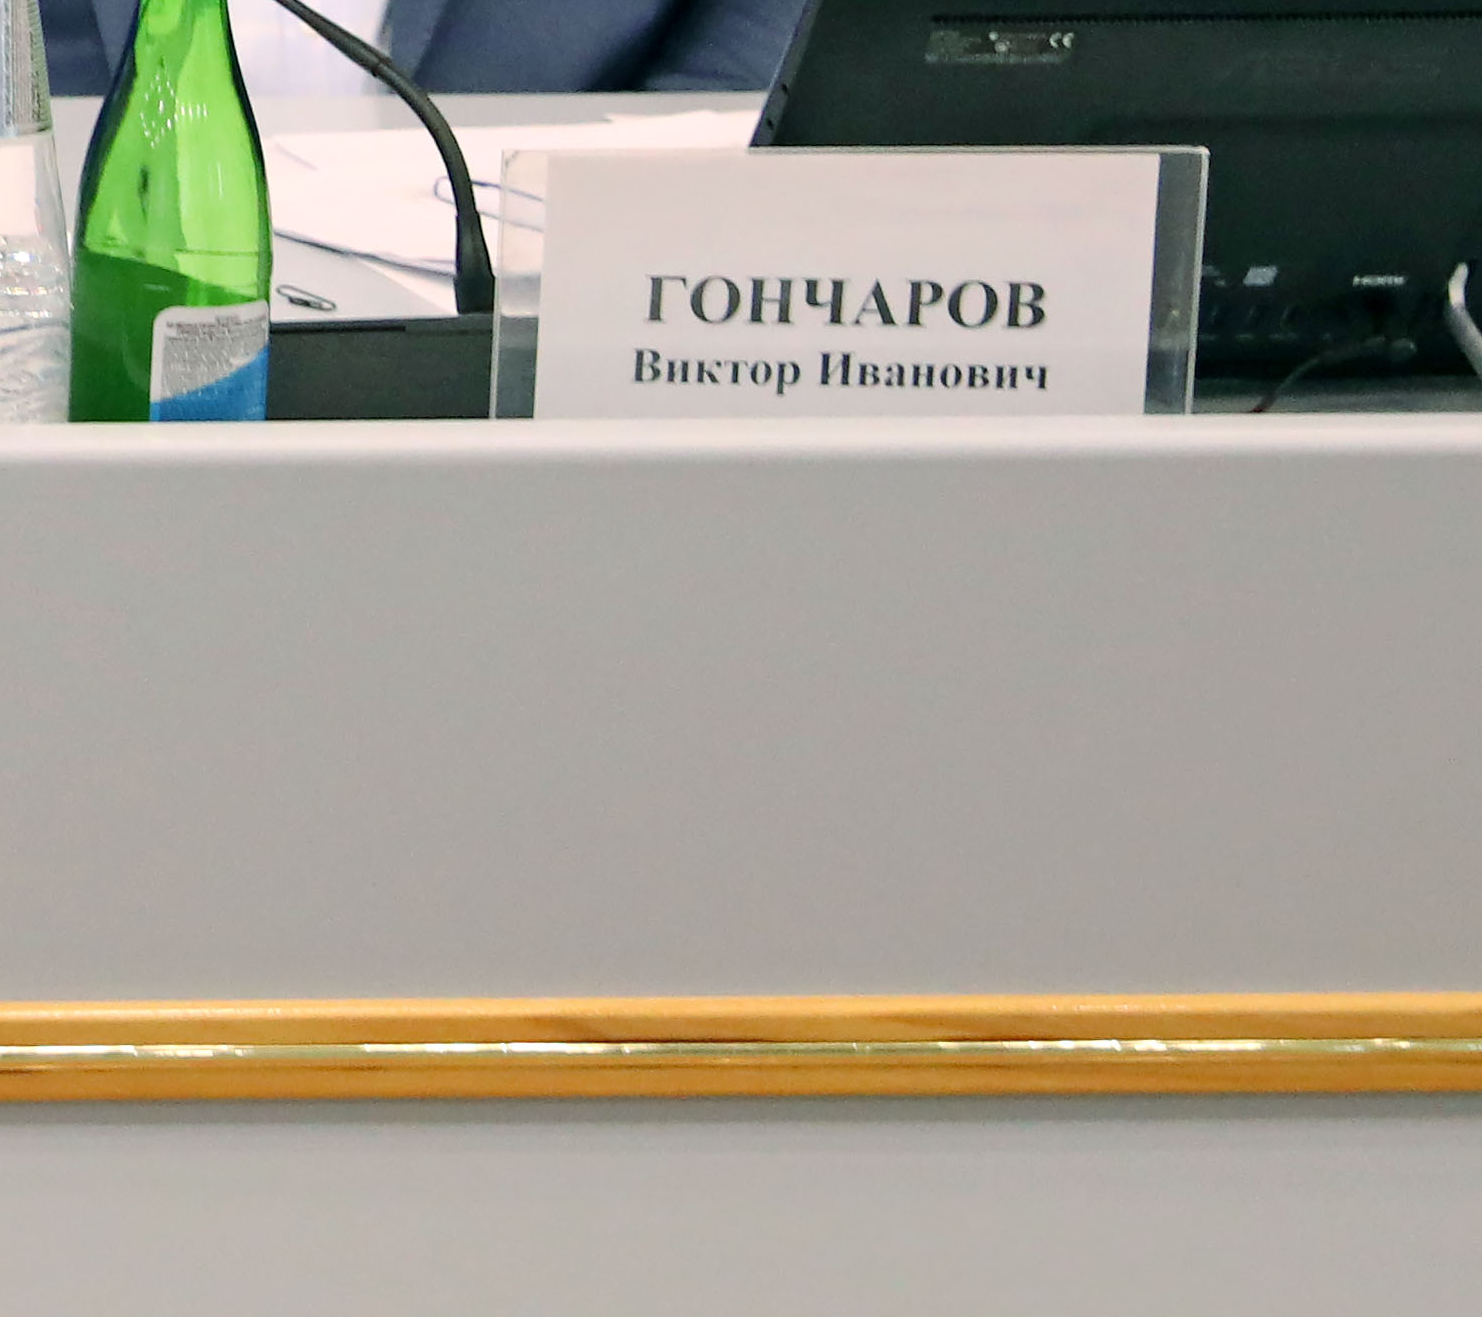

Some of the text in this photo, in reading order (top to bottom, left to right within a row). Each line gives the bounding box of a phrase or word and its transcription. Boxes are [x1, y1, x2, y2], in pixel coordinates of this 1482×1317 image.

[644, 274, 1047, 329] ГОНЧАРОВ
[632, 348, 1049, 396] Виктор Иванович
